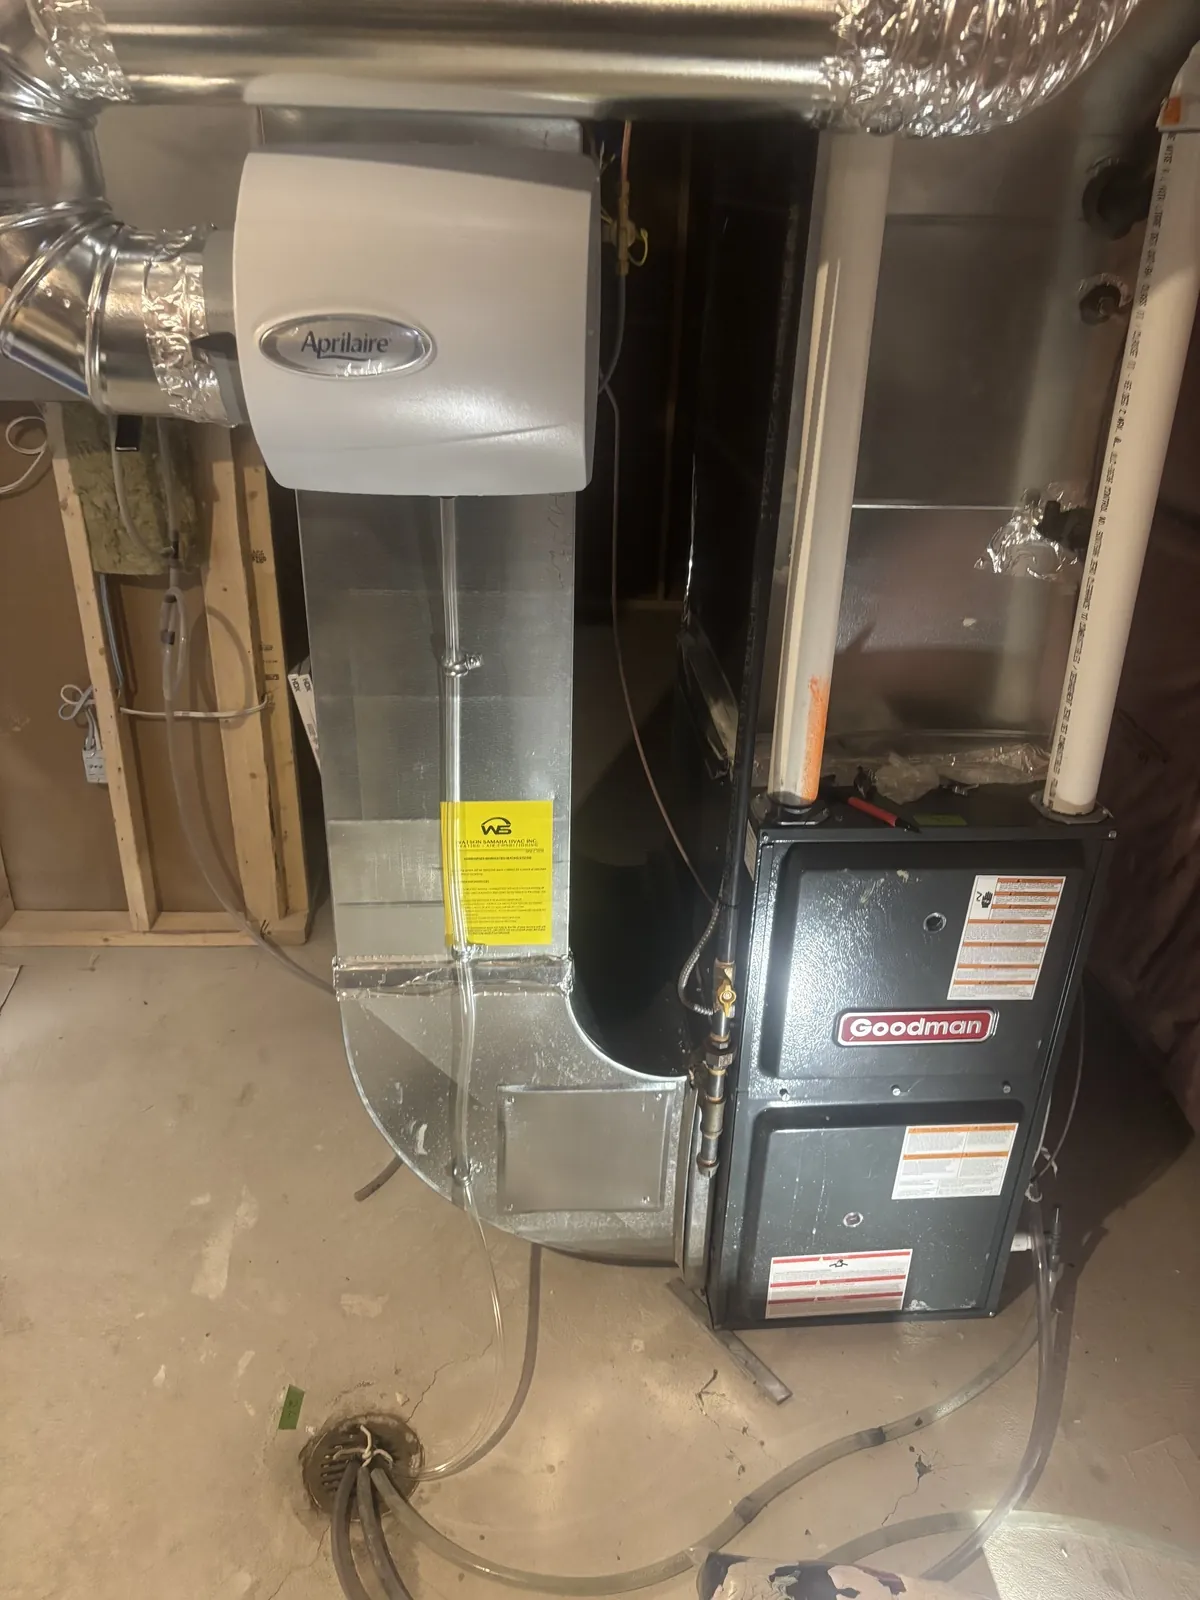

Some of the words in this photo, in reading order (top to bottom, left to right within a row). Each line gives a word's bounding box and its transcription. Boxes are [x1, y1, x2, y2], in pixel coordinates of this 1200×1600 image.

[300, 330, 389, 360] Aprilaire
[291, 678, 301, 692] HDX
[302, 678, 312, 692] HDX
[850, 1017, 982, 1037] Goodman
